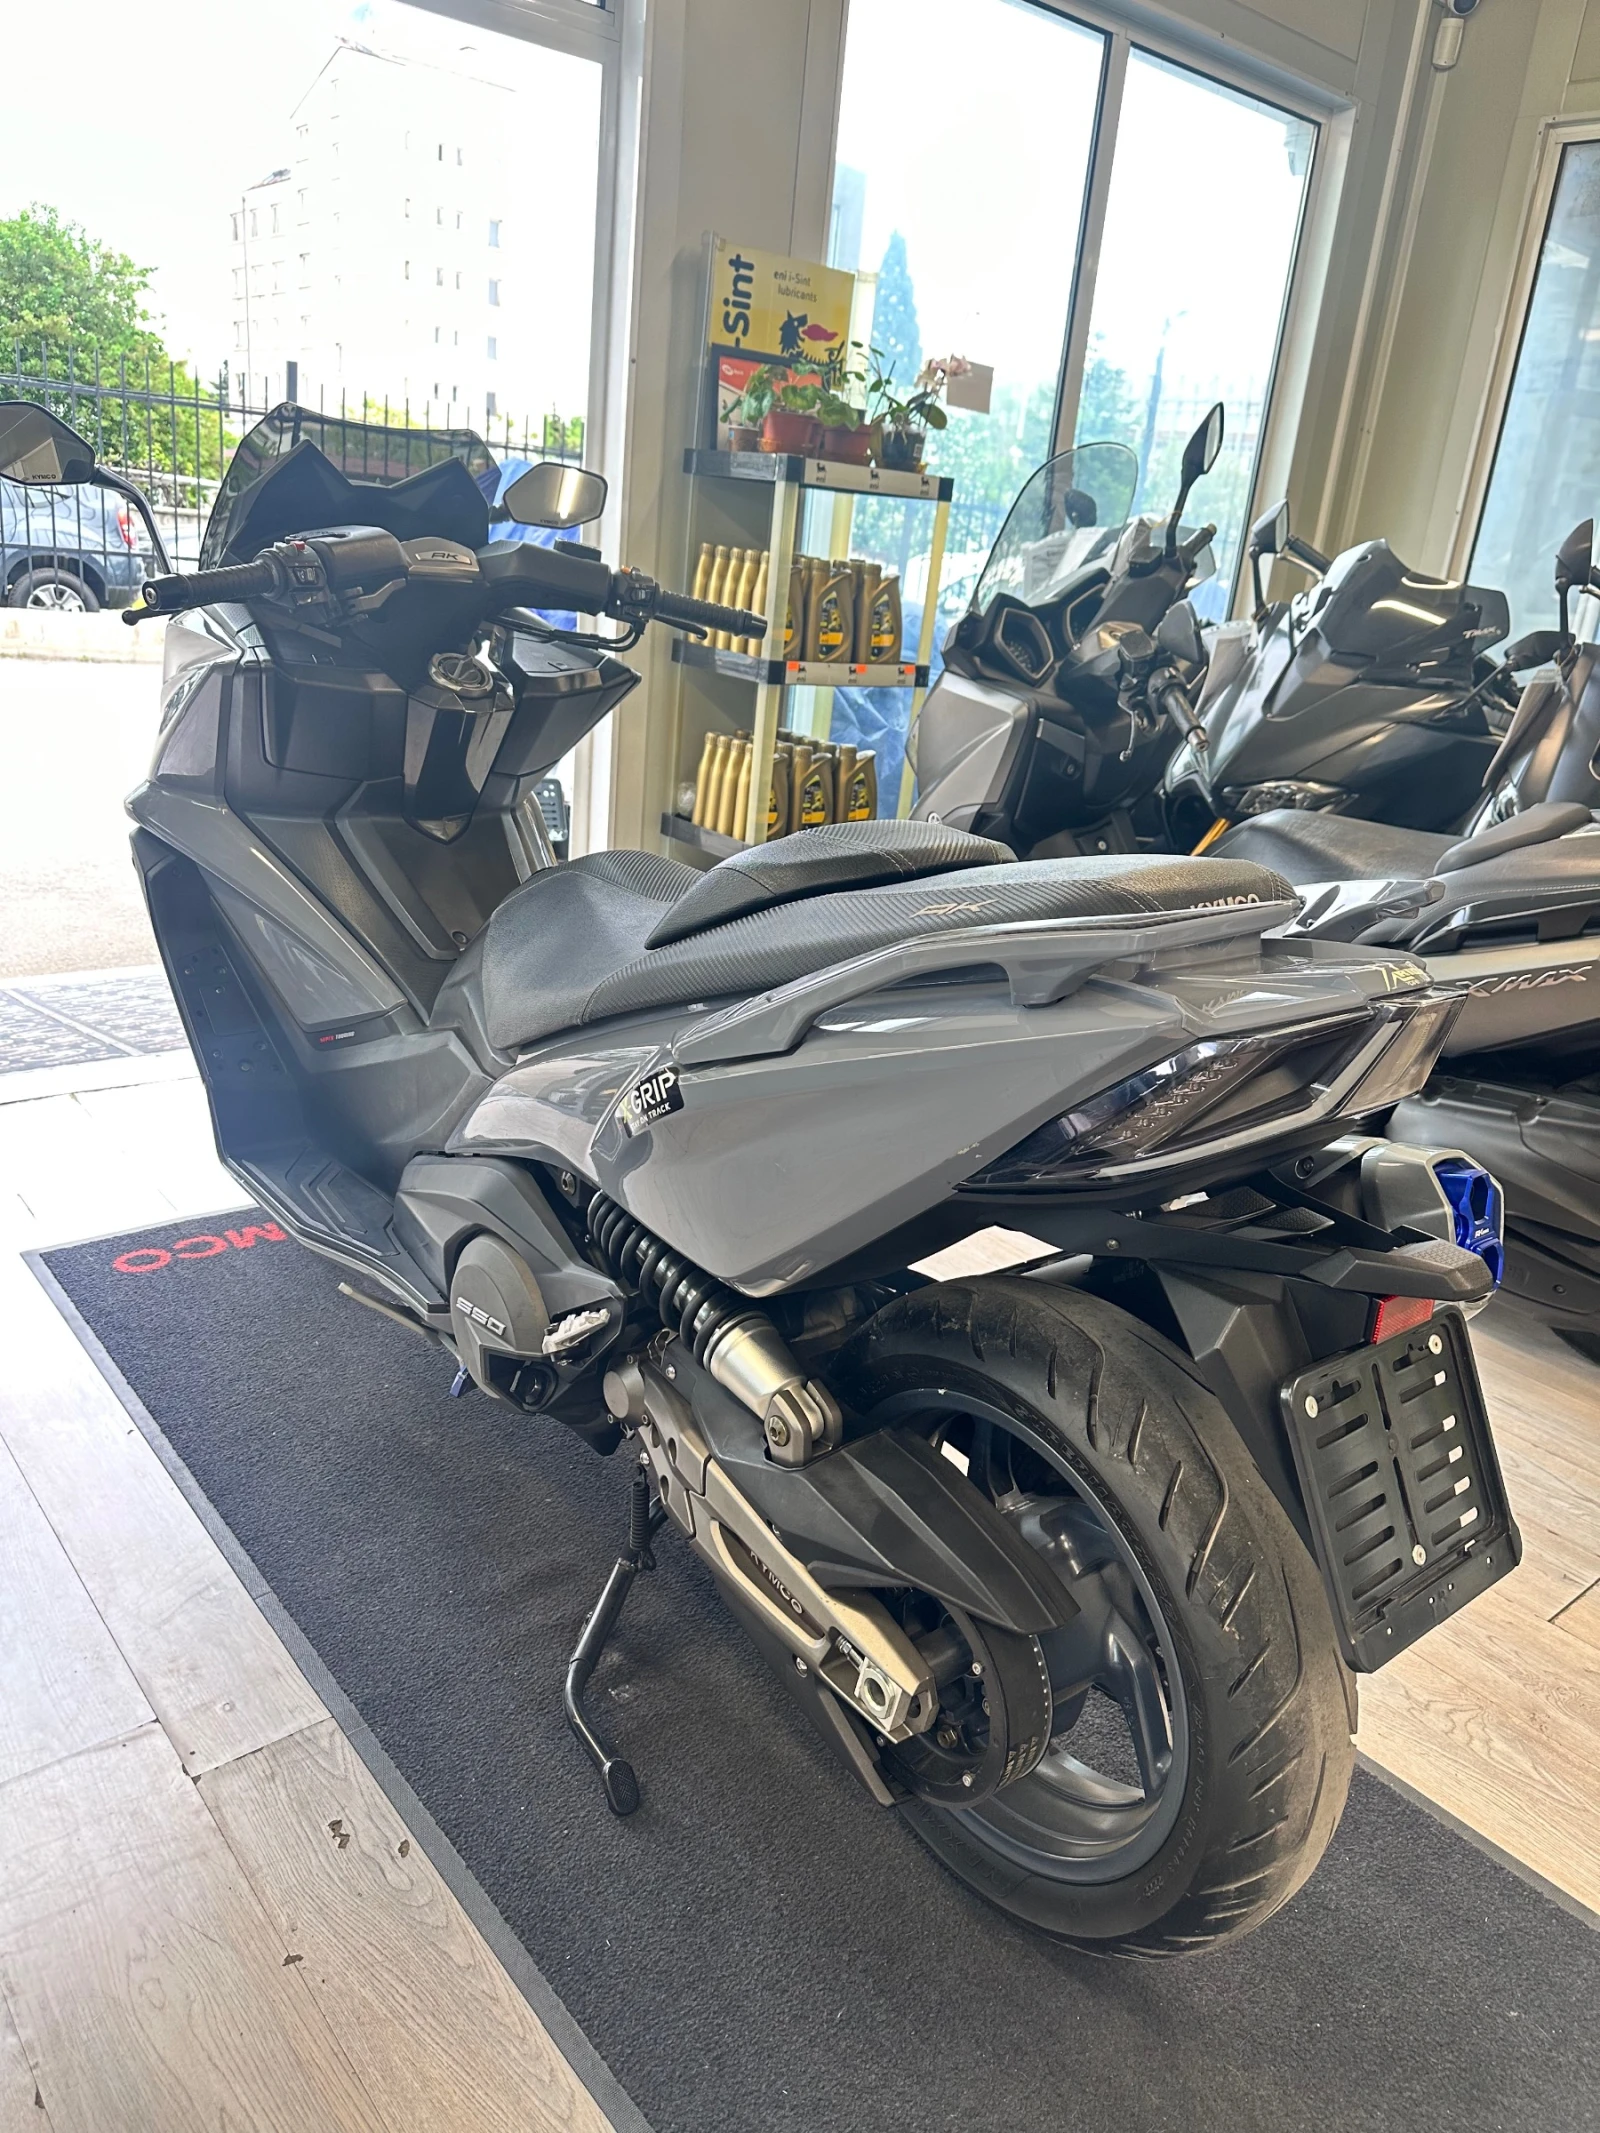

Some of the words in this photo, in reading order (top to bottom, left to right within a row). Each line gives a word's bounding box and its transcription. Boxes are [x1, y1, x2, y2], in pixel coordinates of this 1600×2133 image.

[774, 270, 787, 281] eni
[789, 271, 811, 287] i-Sint
[778, 284, 818, 303] lubricants
[431, 552, 459, 561] AK
[908, 899, 1001, 919] AK
[648, 1102, 671, 1119] TRACK
[112, 1222, 288, 1274] MCO
[456, 1296, 506, 1336] 550
